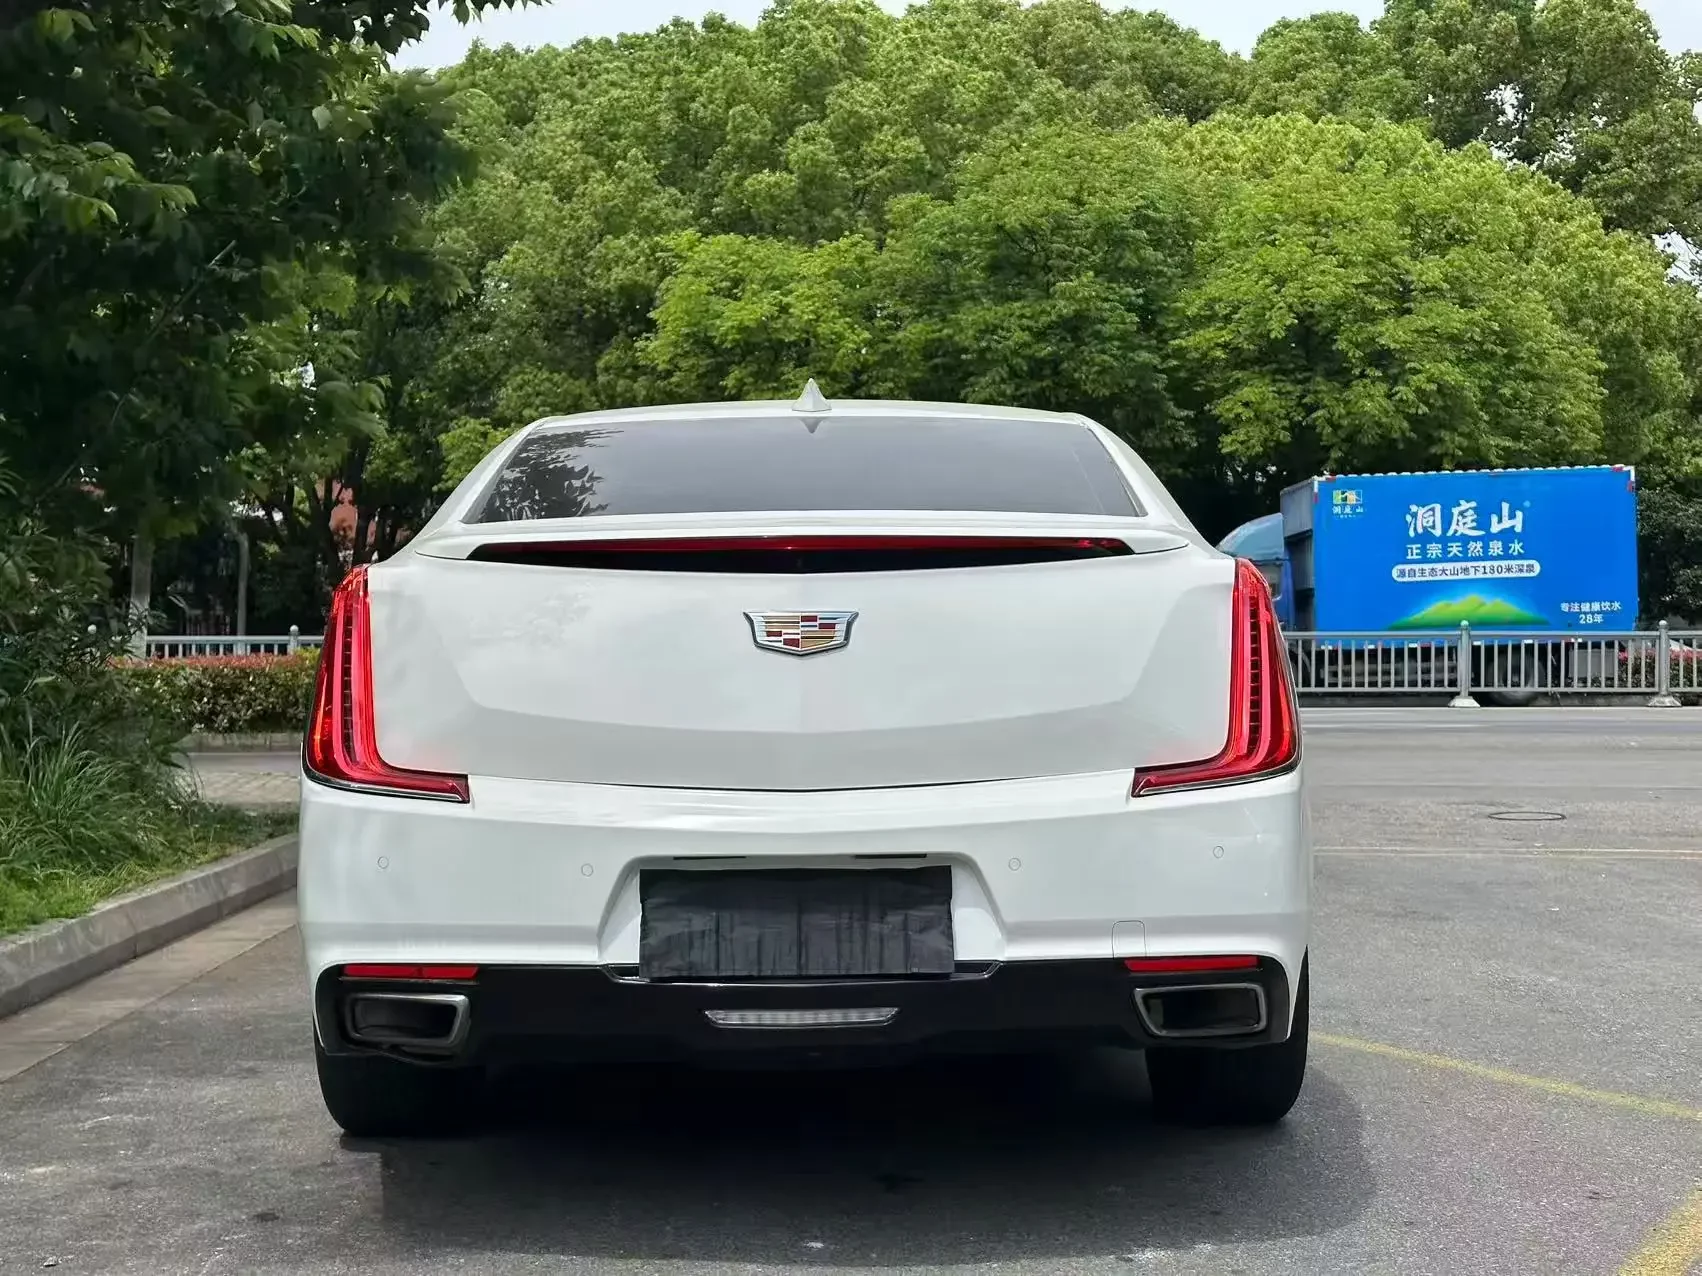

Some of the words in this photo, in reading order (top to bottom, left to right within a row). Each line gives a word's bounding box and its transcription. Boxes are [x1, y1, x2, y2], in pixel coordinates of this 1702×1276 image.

[1406, 500, 1523, 537] 洞庭山
[1405, 540, 1525, 560] 正宗天然泉水
[1560, 601, 1622, 612] 专注健康饮水
[1579, 614, 1604, 624] 28年
